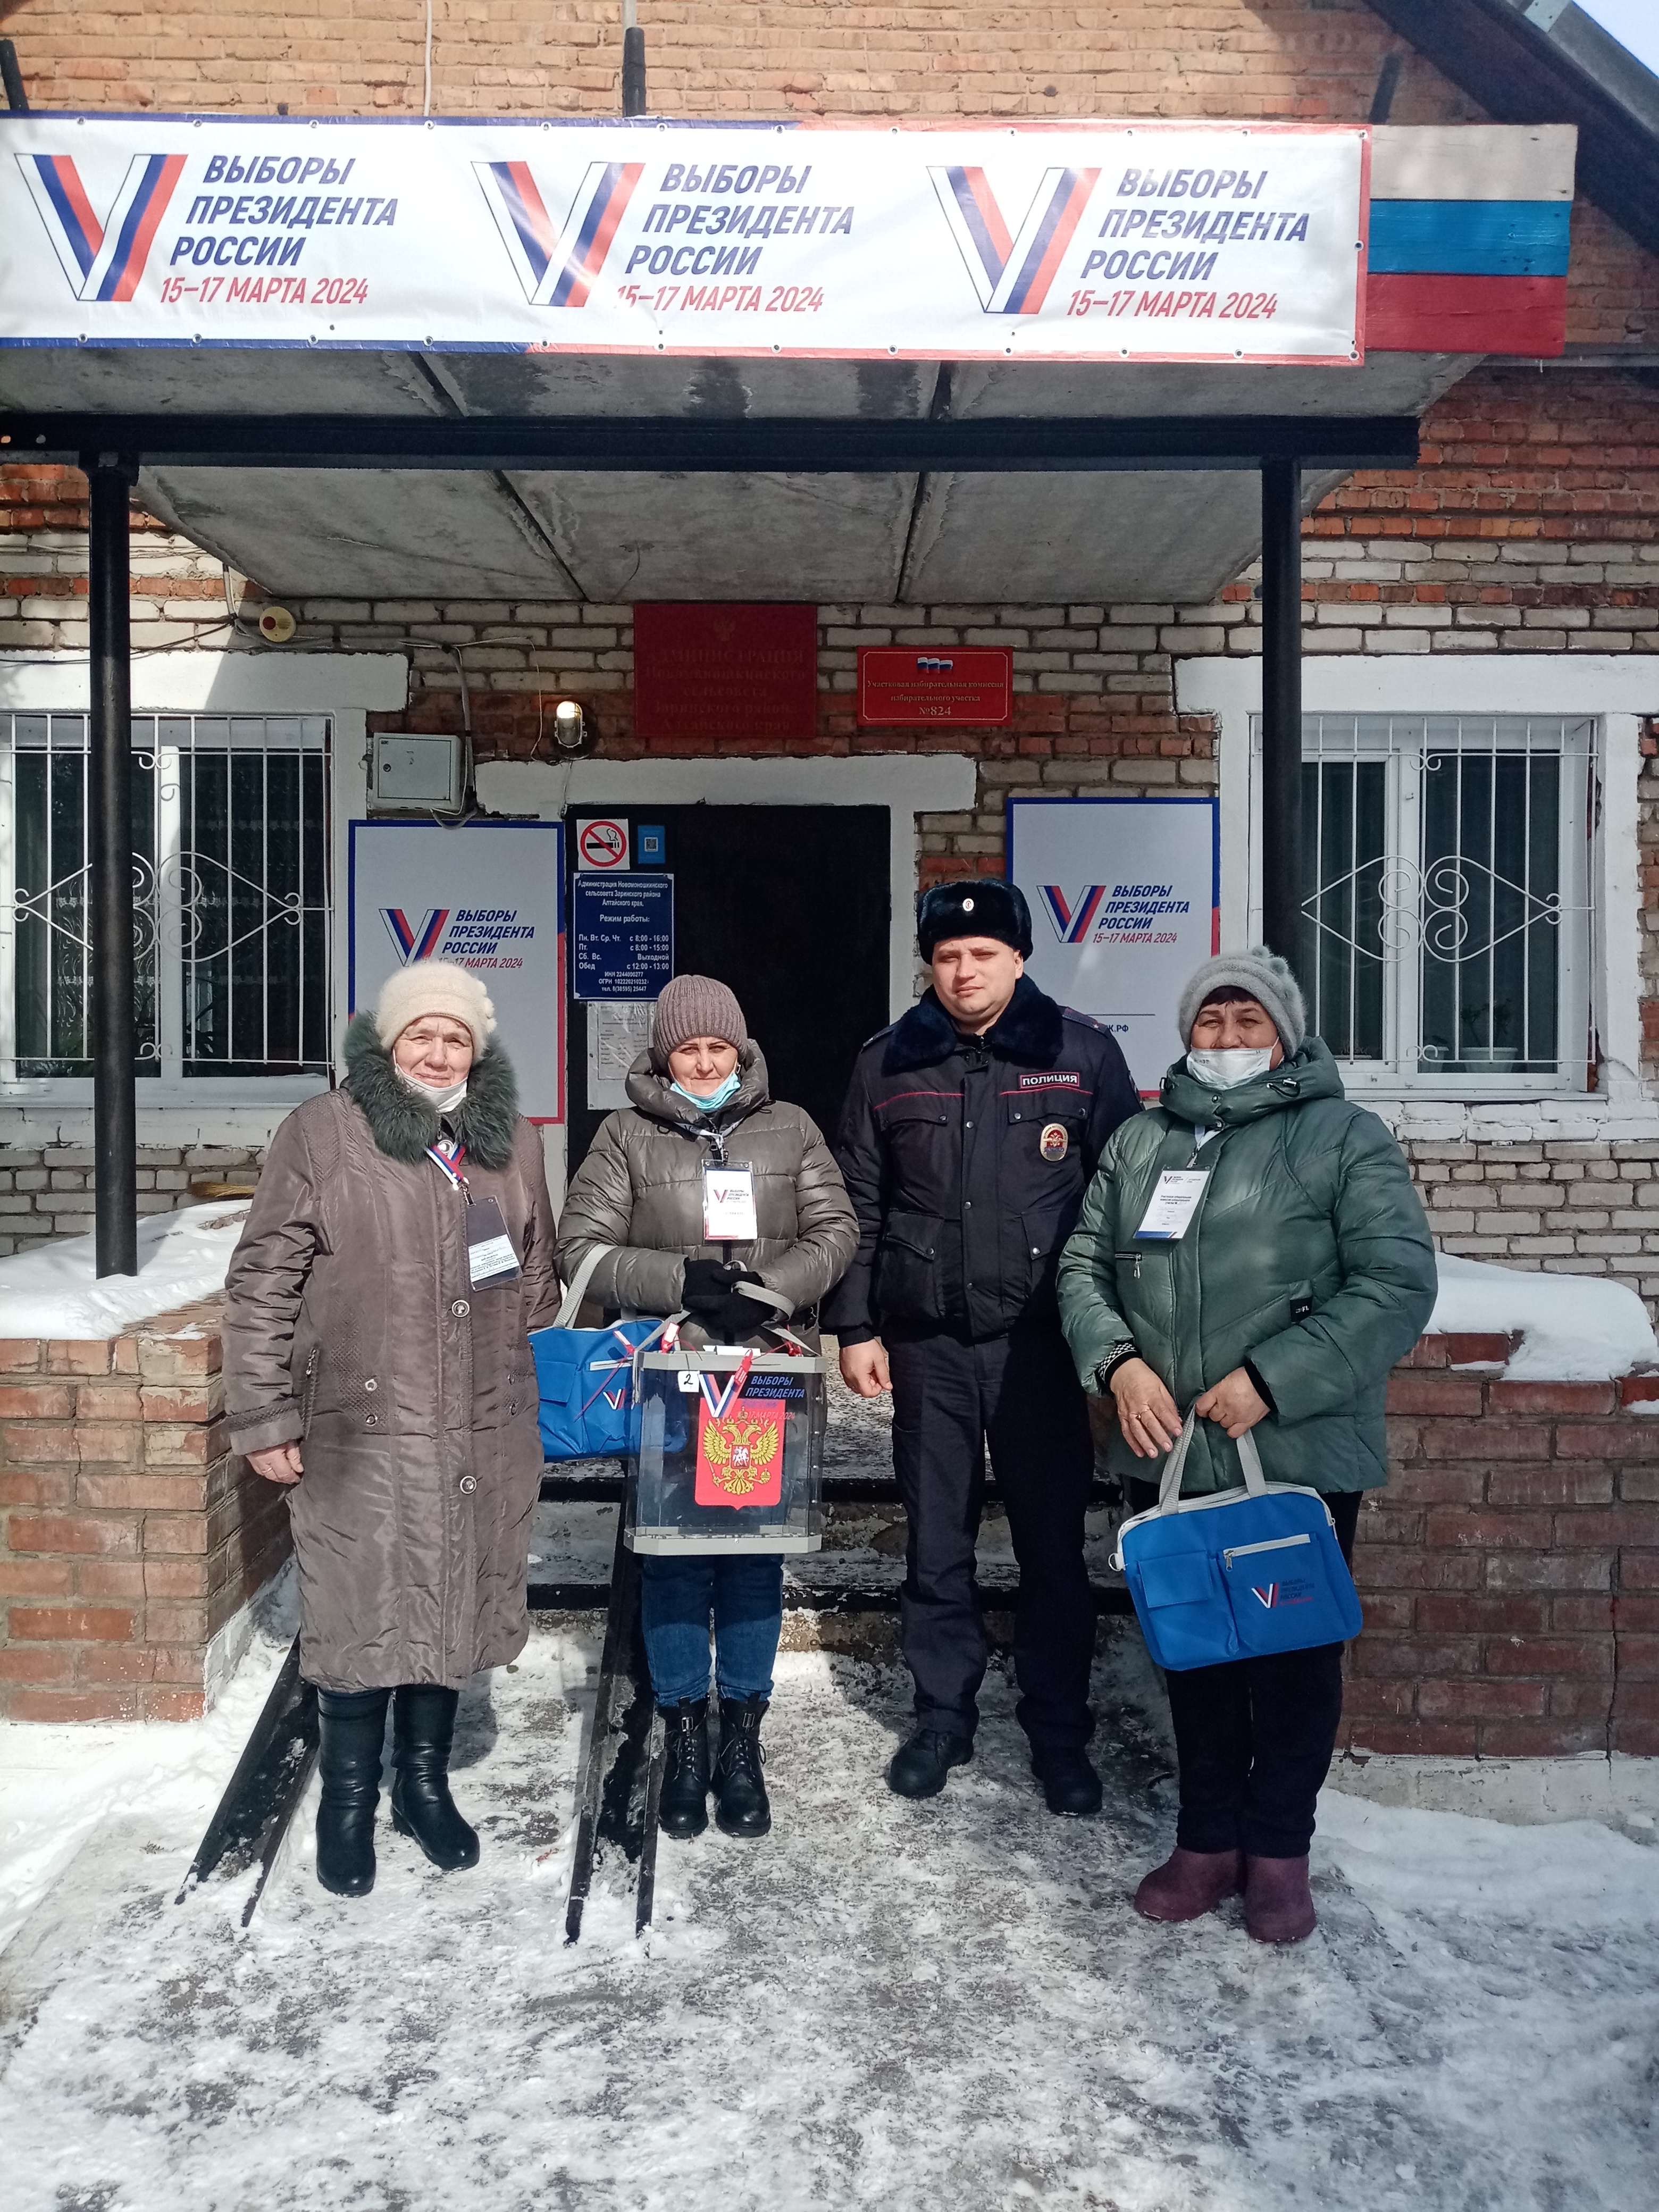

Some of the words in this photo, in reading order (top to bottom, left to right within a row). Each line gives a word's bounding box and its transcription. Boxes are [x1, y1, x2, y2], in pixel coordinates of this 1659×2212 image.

[203, 155, 355, 185] ВЫБОРЫ
[659, 164, 812, 194] ВЫБОРЫ
[1116, 169, 1268, 199] ВЫБОРЫ
[186, 196, 398, 229] ПРЕЗИДЕНТА
[643, 204, 854, 238] ПРЕЗИДЕНТА
[1098, 210, 1310, 244] ПРЕЗИДЕНТА
[170, 237, 306, 266] РОССИИ
[625, 246, 763, 275] РОССИИ
[1080, 250, 1218, 280] РОССИИ
[226, 278, 307, 304] МАРТА
[311, 278, 368, 304] 2024
[680, 286, 762, 311] МАРТА
[765, 286, 824, 312] 2024
[1135, 291, 1217, 318] МАРТА
[1220, 292, 1278, 319] 2024
[911, 680, 967, 689] избирательная
[891, 694, 950, 702] избирательного
[919, 706, 951, 716] №824
[577, 880, 617, 889] Администрация
[1112, 885, 1172, 898] ВЫБОРЫ
[1105, 901, 1190, 915] ПРЕЗИДЕНТА
[456, 909, 517, 923] ВЫБОРЫ
[623, 915, 650, 924] работы:
[1098, 917, 1153, 929] РОССИИ
[449, 926, 535, 940] ПРЕЗИДЕНТА
[1120, 933, 1153, 943] МАРТА
[1154, 933, 1178, 943] 2024
[442, 942, 498, 954] РОССИИ
[465, 958, 498, 968] МАРТА
[499, 958, 523, 968] 2024
[1023, 1075, 1077, 1085] ПОЛИЦИЯ
[684, 1375, 693, 1385] 2
[751, 1376, 794, 1386] ВЫБОРЫ
[745, 1388, 805, 1398] ПРЕЗИДЕНТА
